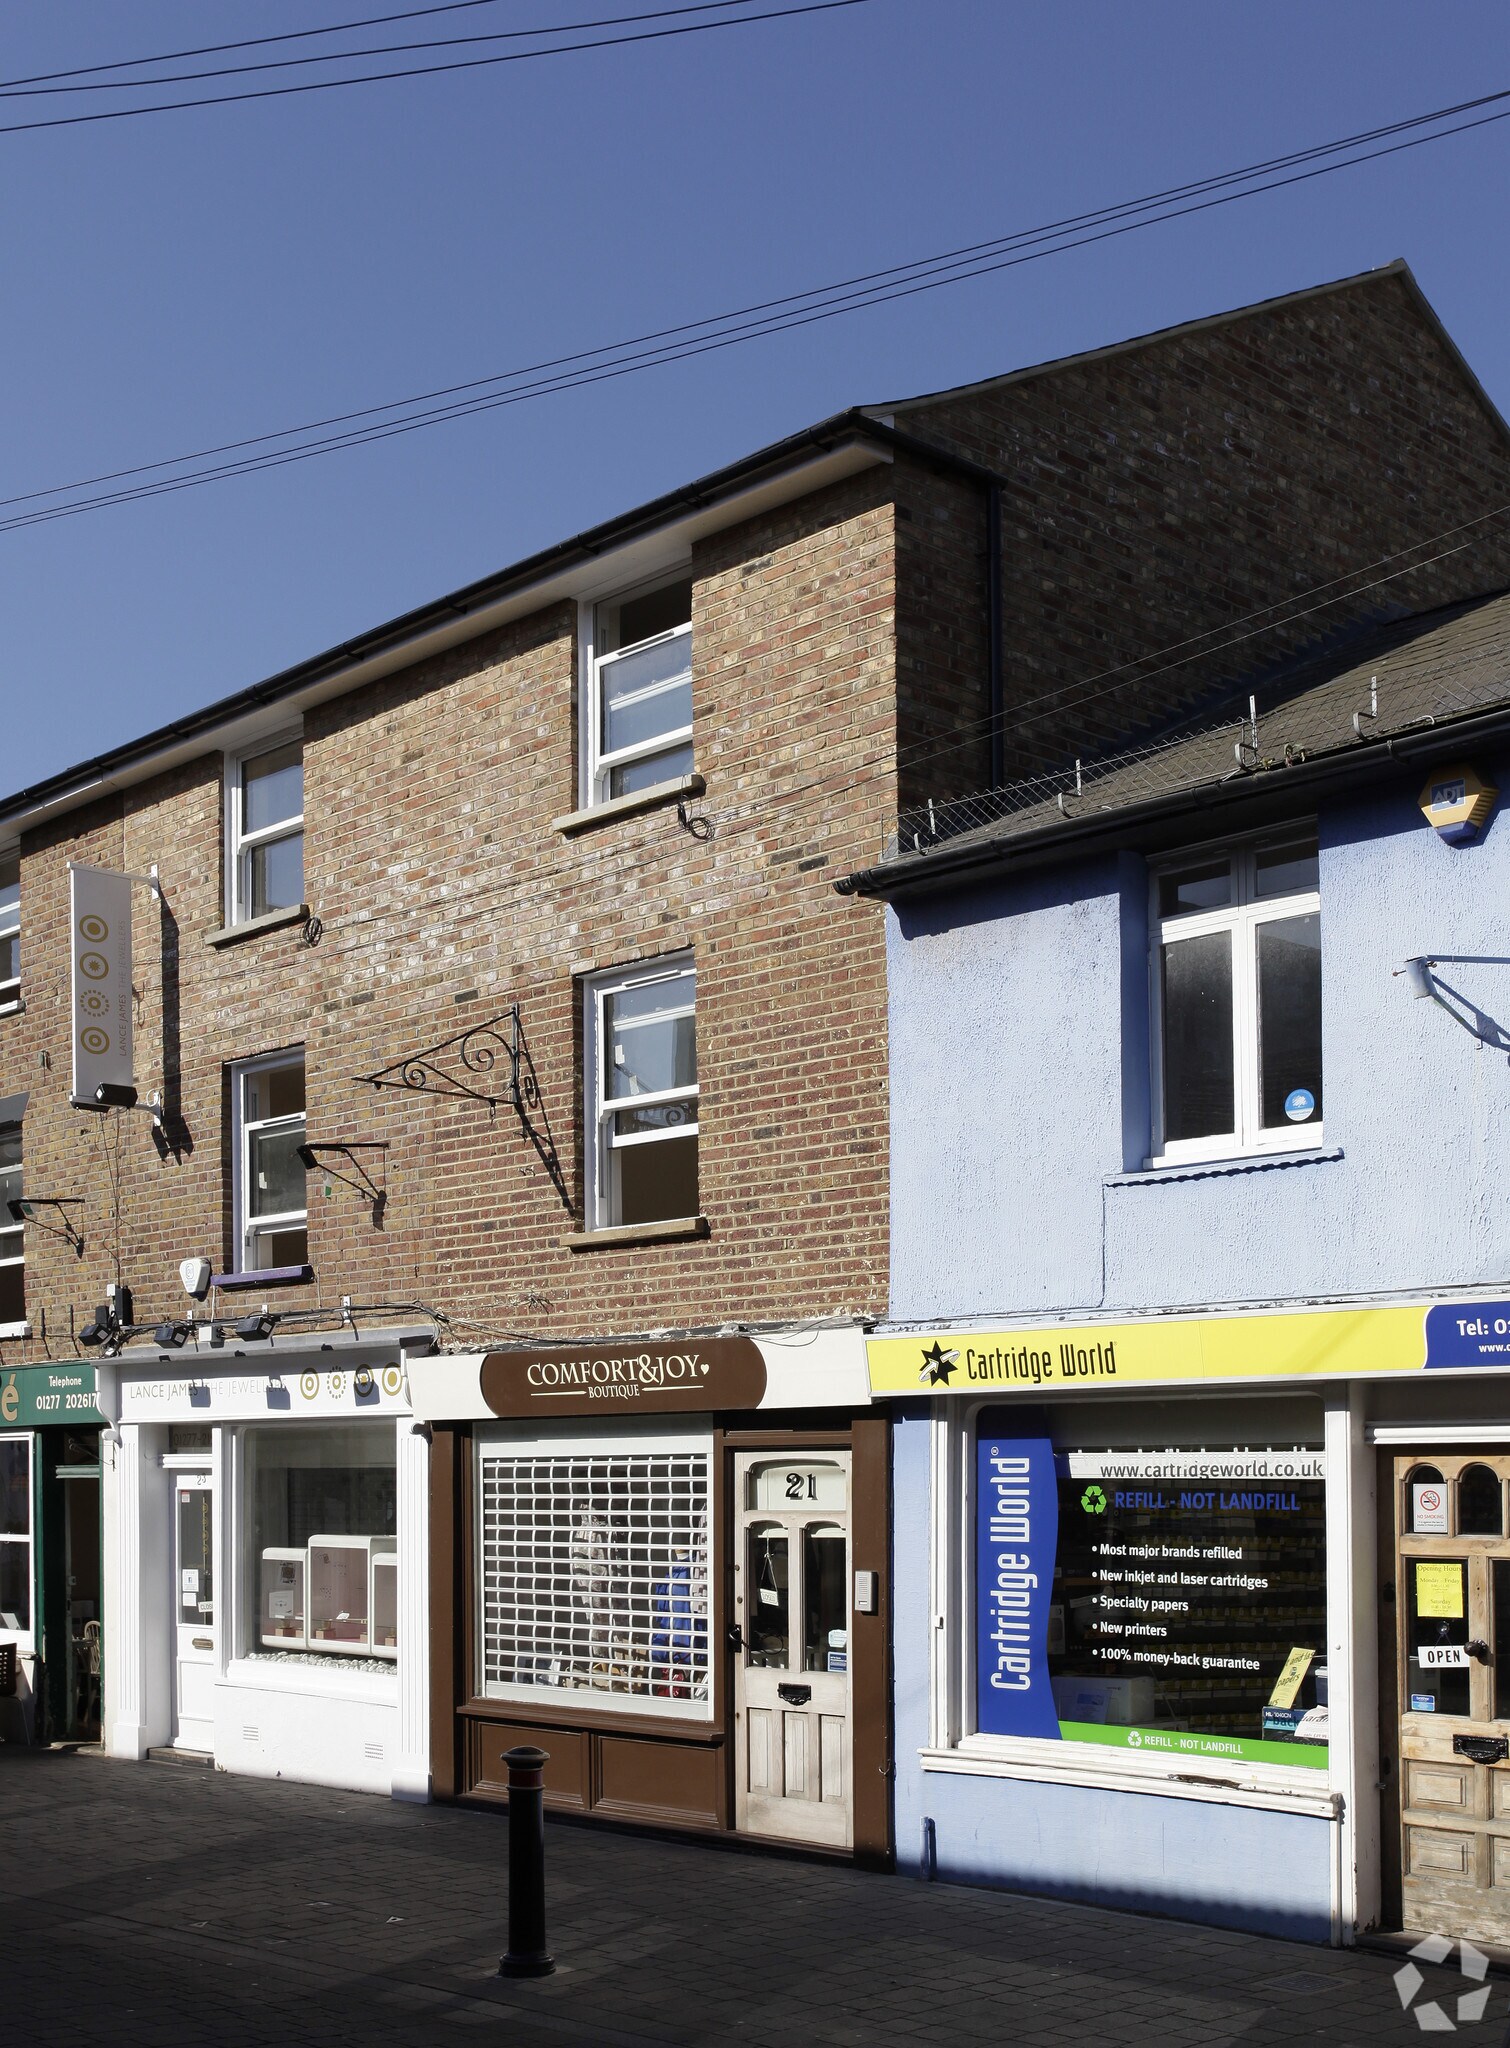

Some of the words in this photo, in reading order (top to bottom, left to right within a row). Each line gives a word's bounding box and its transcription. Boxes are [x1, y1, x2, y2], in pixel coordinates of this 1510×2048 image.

[1433, 785, 1465, 804] ADT
[118, 920, 127, 969] JEWELLERS
[119, 994, 129, 1022] JAMES
[119, 1024, 127, 1057] LANCE
[1456, 1318, 1489, 1336] Tel:
[1494, 1318, 1510, 1335] 0
[966, 1346, 1053, 1384] Cartridge
[1059, 1341, 1117, 1377] World
[48, 1375, 82, 1388] Telephone
[130, 1383, 165, 1399] LANCE
[167, 1381, 198, 1401] JAMES
[36, 1395, 61, 1410] 01277
[65, 1393, 97, 1409] 202617
[588, 1384, 640, 1400] BOUTIQUE
[1100, 1459, 1324, 1479] www.cartridgeworld.co.uk
[785, 1472, 817, 1500] 21
[1115, 1491, 1166, 1509] REFILL
[1180, 1492, 1215, 1510] NOT
[1220, 1492, 1300, 1511] LANDFILL
[1100, 1543, 1127, 1556] Most
[1129, 1544, 1160, 1559] major
[1162, 1545, 1200, 1558] brands
[1202, 1546, 1243, 1559] refilled
[1100, 1569, 1123, 1582] New
[1124, 1570, 1155, 1585] inkjet
[1157, 1572, 1178, 1584] and
[1180, 1572, 1208, 1585] laser
[1210, 1574, 1269, 1590] cartridges
[1100, 1595, 1149, 1612] Specialty
[1151, 1600, 1189, 1613] papers
[990, 1553, 1038, 1690] Cartridge
[1100, 1621, 1123, 1634] New
[1125, 1622, 1167, 1637] printers
[1100, 1648, 1132, 1660] 100%
[1133, 1652, 1201, 1666] money-back
[1202, 1656, 1260, 1670] guarantee
[1427, 1650, 1461, 1663] OPEN
[1144, 1735, 1172, 1747] REFILL
[1180, 1739, 1199, 1750] NOT
[1201, 1741, 1243, 1754] LANDFILL
